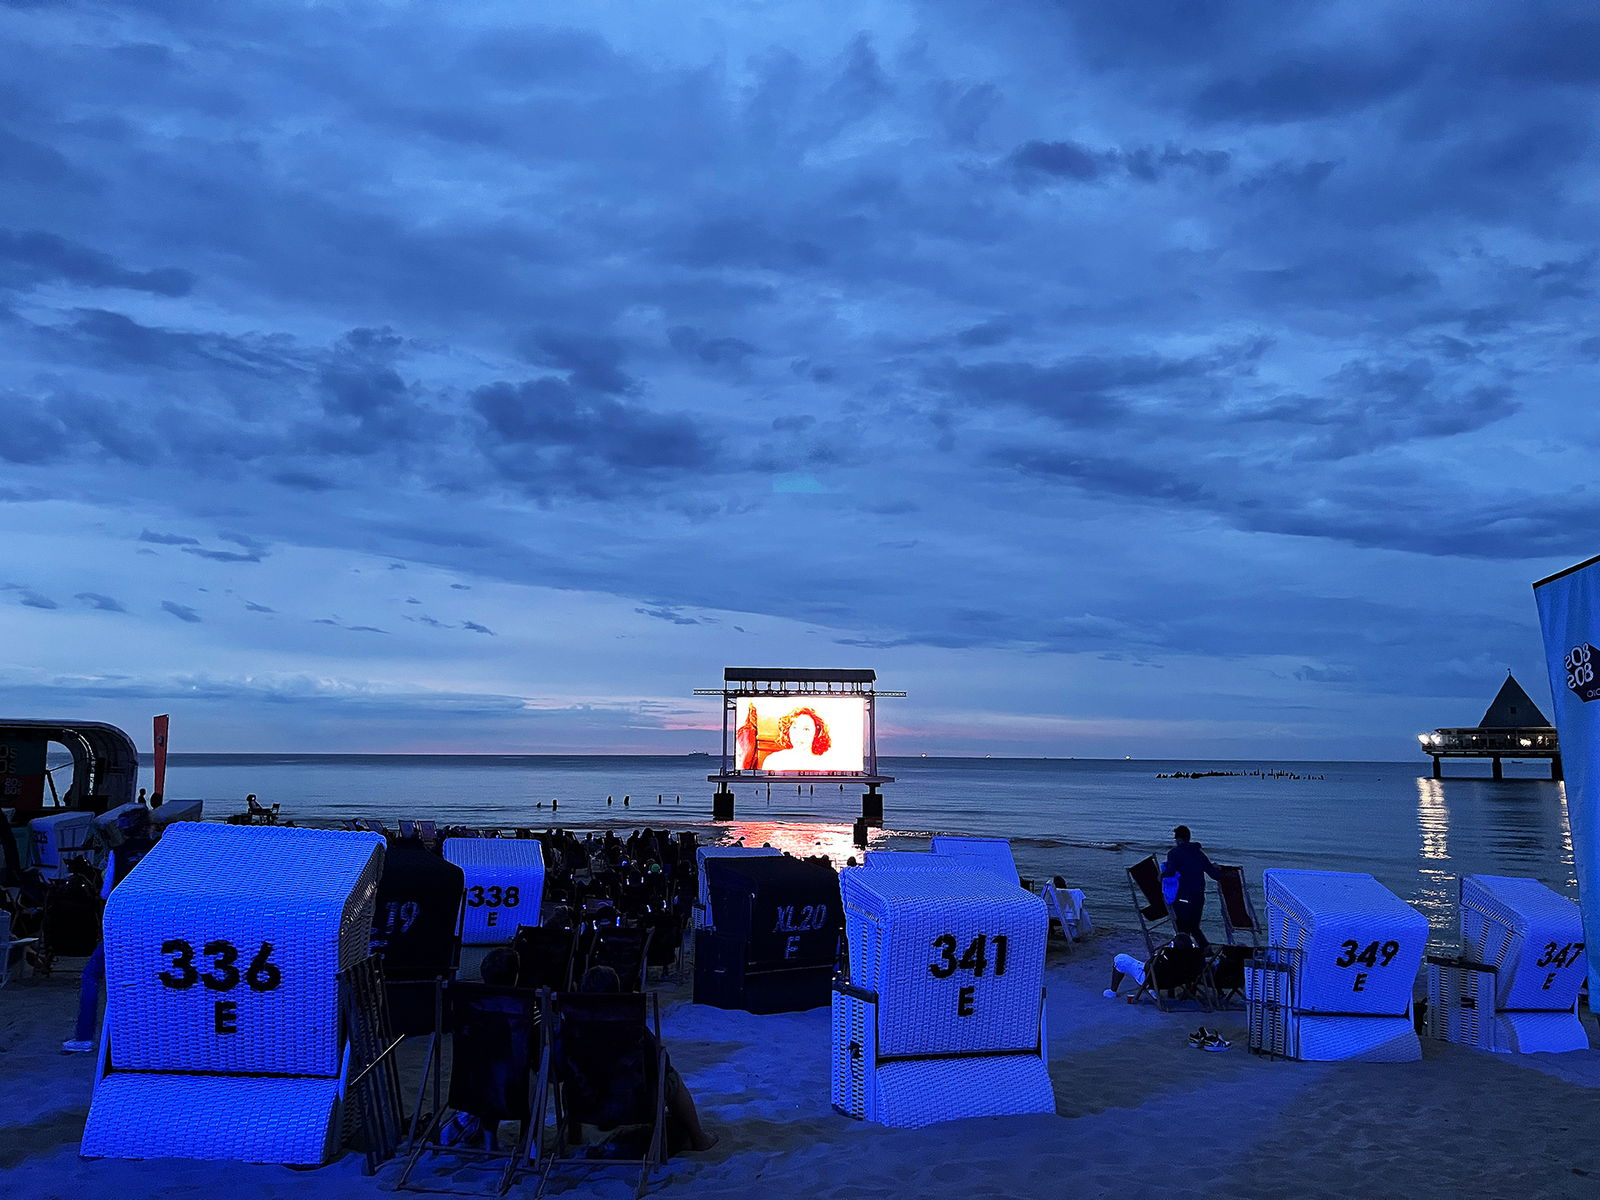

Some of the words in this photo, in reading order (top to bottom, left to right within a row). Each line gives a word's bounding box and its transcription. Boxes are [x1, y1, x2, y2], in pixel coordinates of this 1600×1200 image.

[468, 886, 520, 908] 338
[487, 912, 498, 926] E
[159, 938, 281, 992] 336
[929, 933, 1009, 979] 341
[1336, 939, 1400, 968] 349
[1536, 941, 1585, 968] 347
[1353, 973, 1368, 992] E
[1542, 972, 1557, 991] E
[957, 986, 975, 1017] E
[214, 1001, 237, 1035] E
